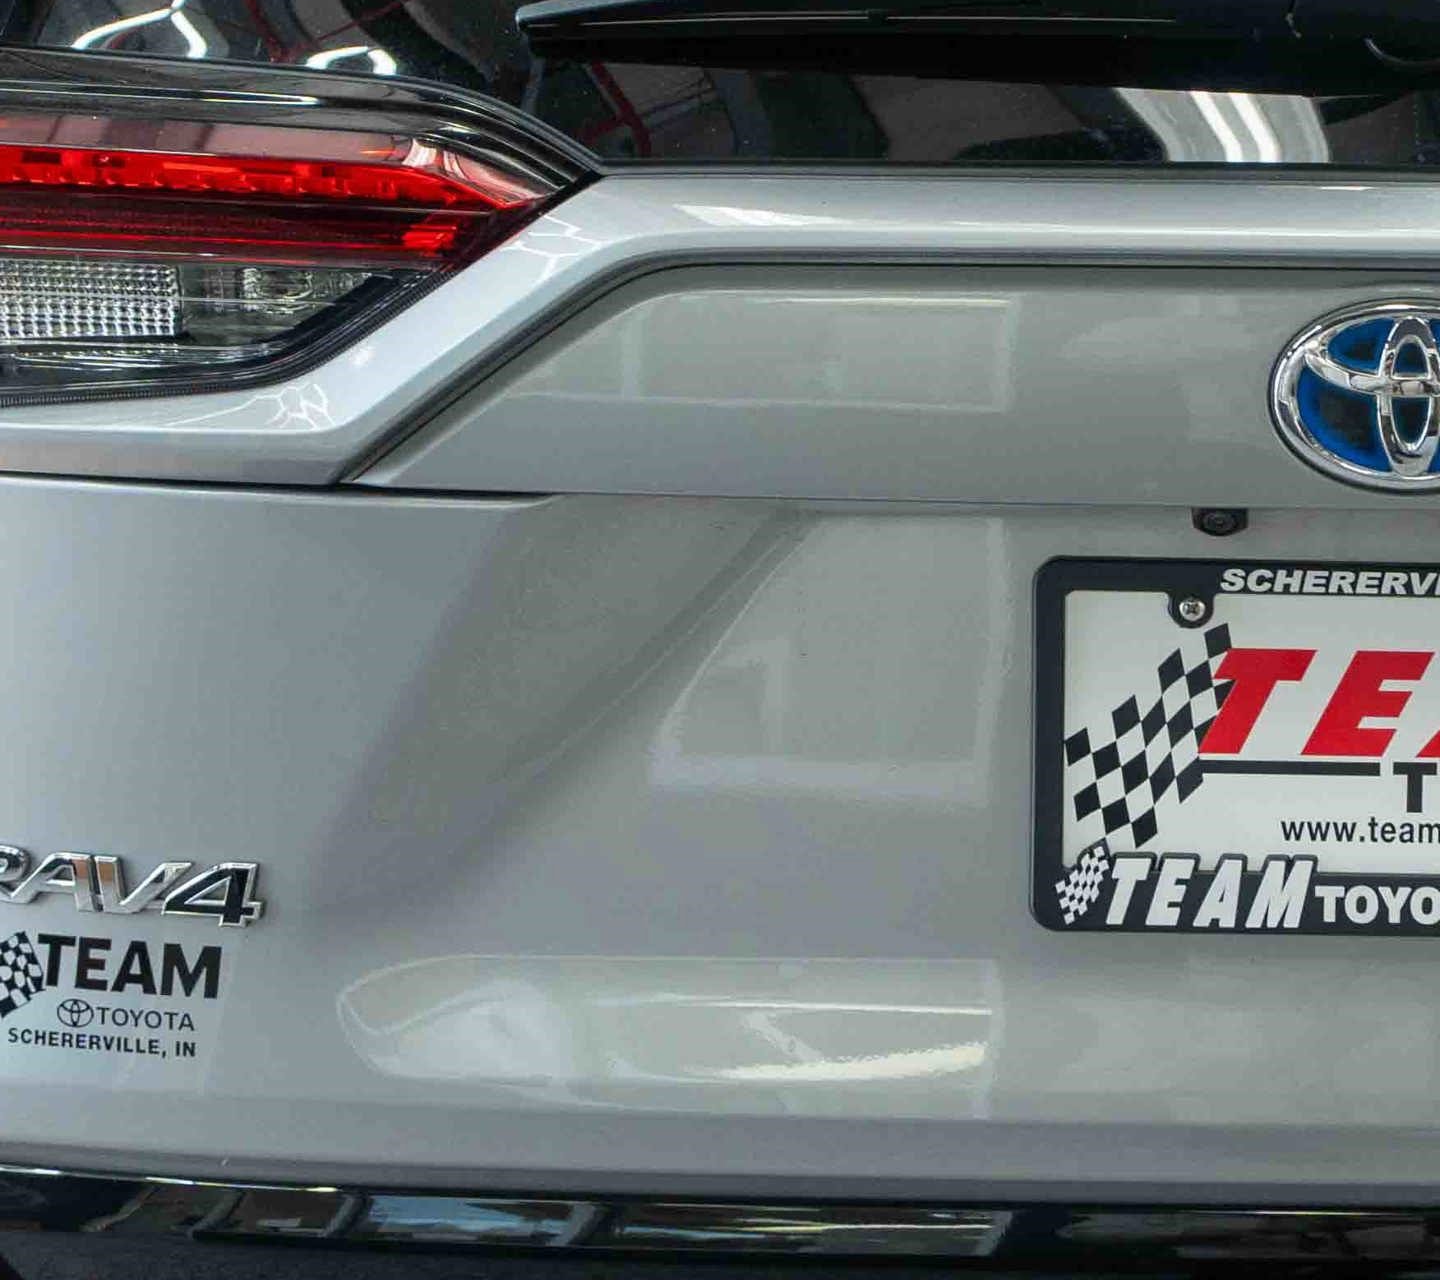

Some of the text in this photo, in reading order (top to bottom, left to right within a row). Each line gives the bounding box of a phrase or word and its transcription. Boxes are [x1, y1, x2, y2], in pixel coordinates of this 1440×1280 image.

[37, 932, 223, 1000] TEAM
[95, 1006, 195, 1032] TOYOTA
[8, 1026, 197, 1059] SCHERERVILLE, IN
